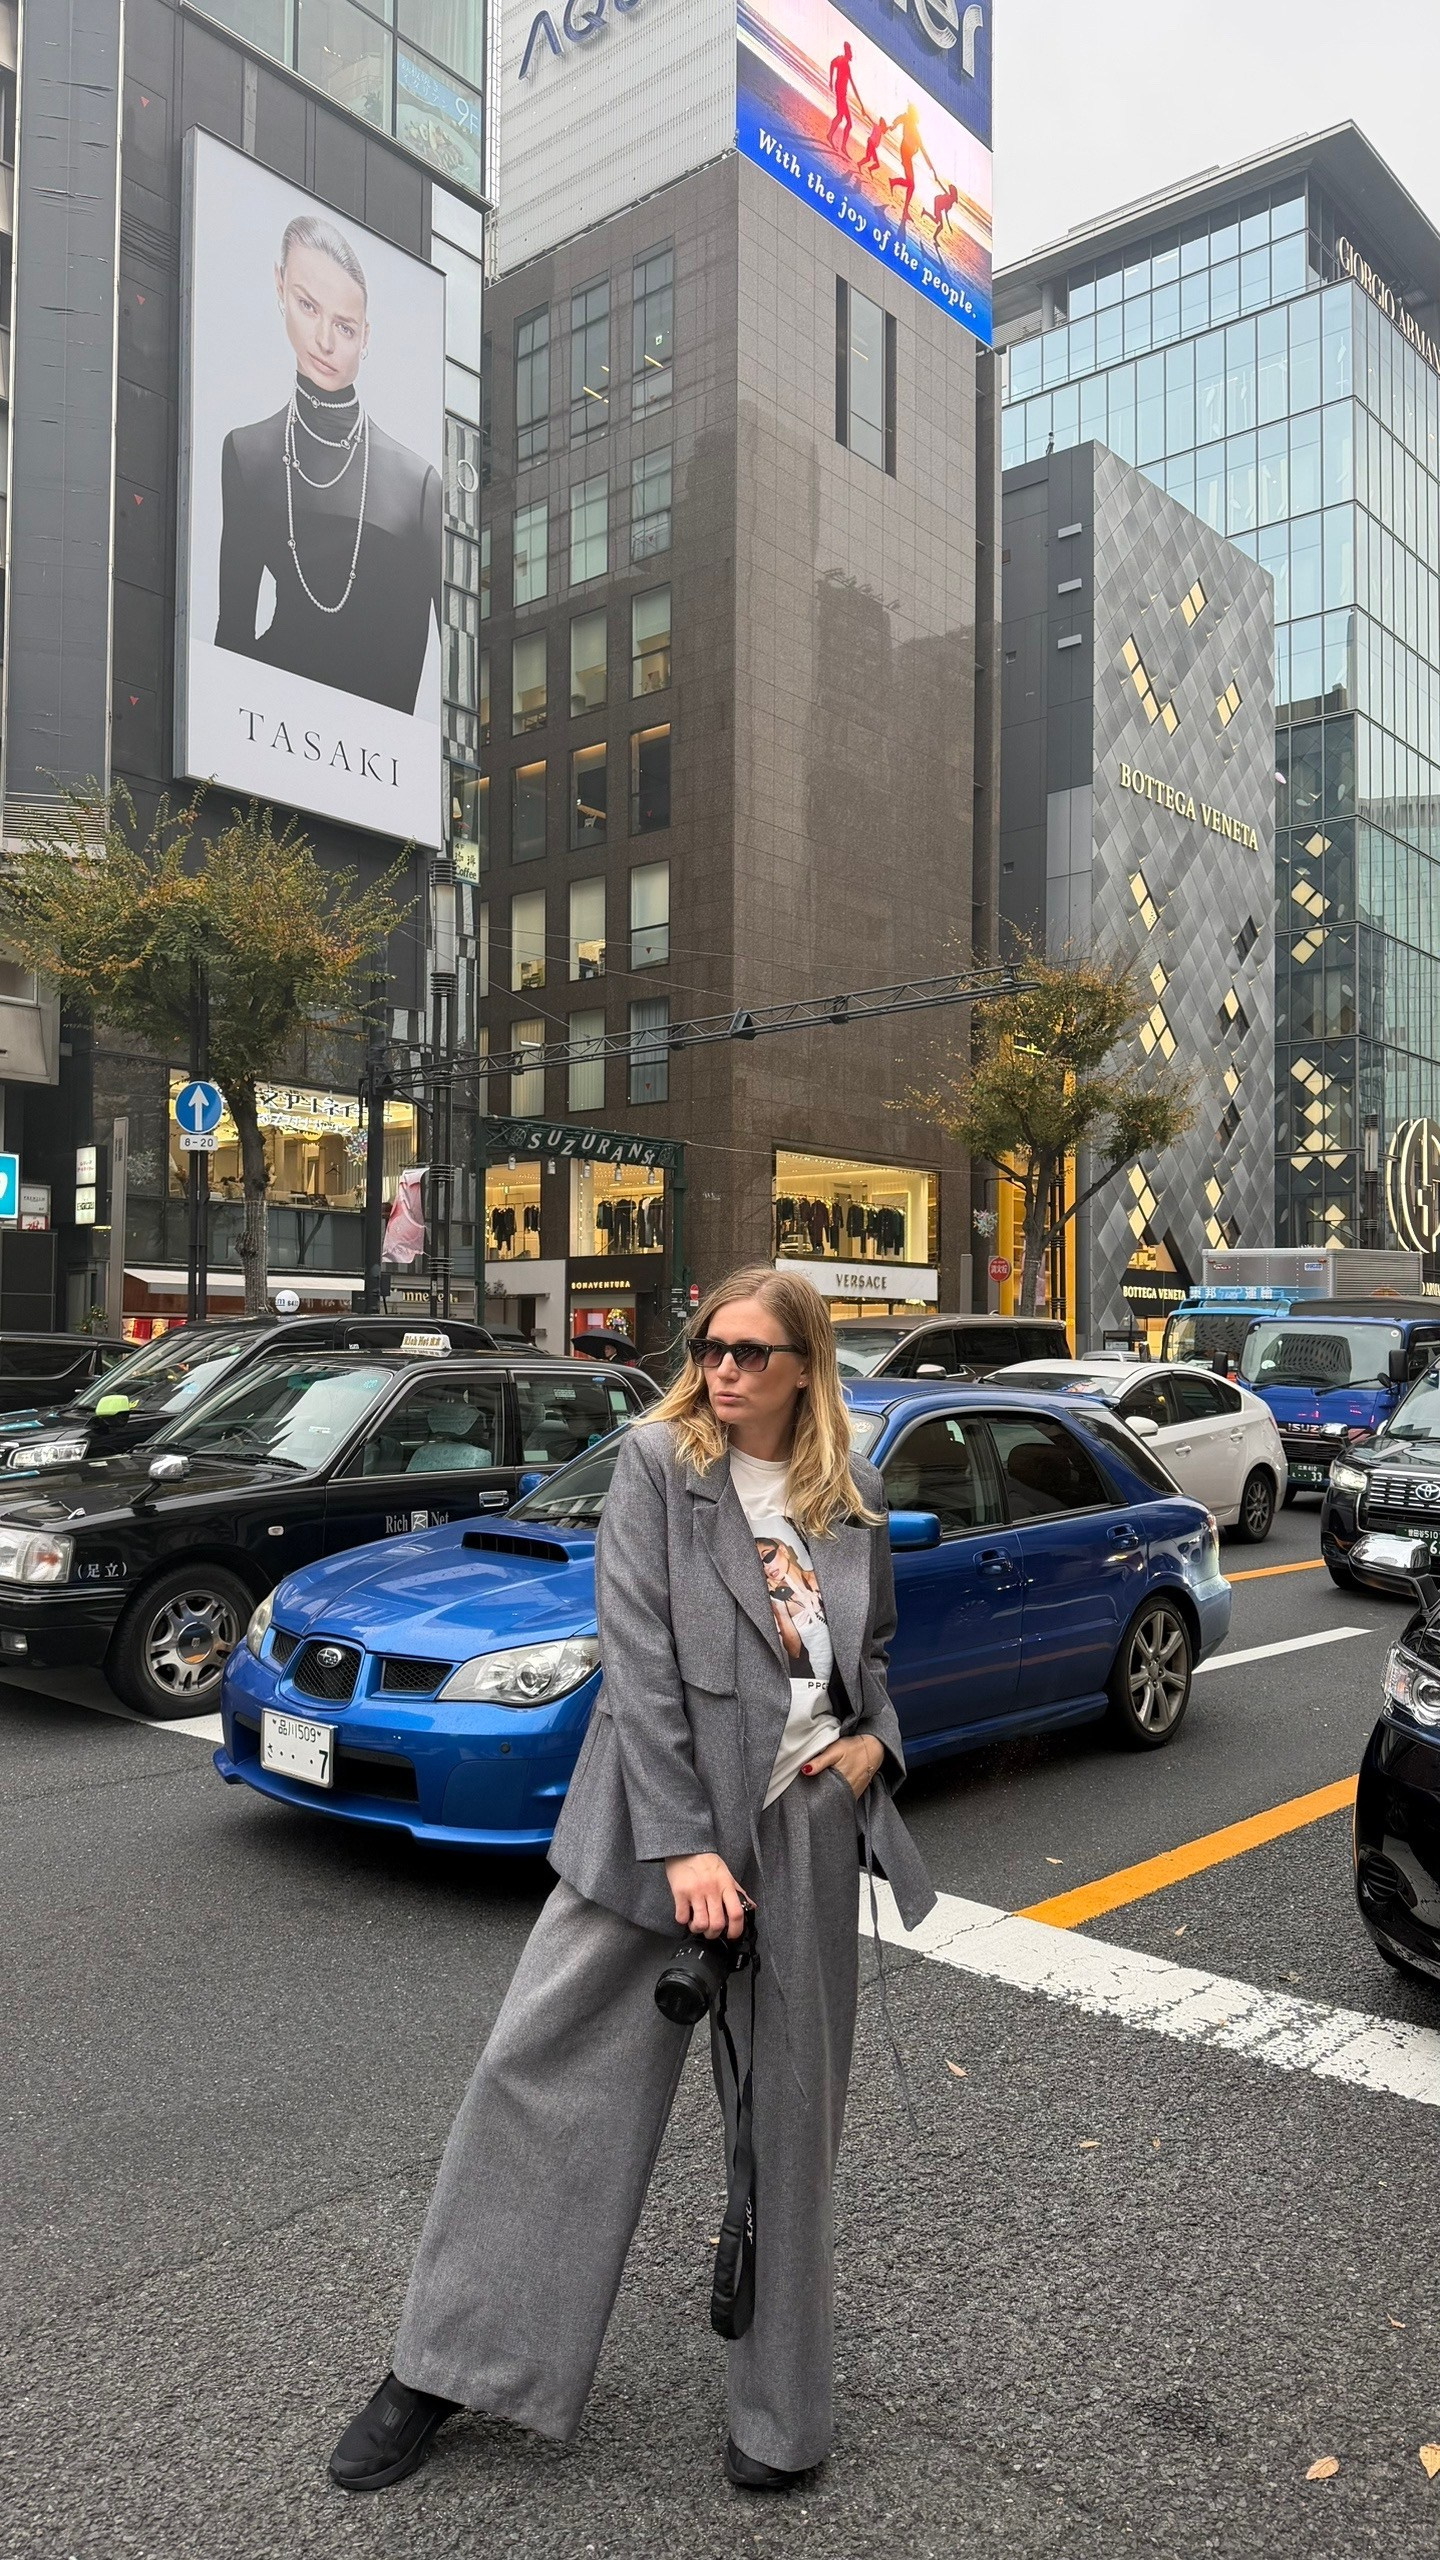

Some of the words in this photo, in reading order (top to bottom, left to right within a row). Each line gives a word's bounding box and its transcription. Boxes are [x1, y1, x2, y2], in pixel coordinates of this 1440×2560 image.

[893, 0, 983, 78] er
[455, 97, 479, 134] 9F
[758, 128, 801, 178] With
[807, 171, 835, 204] the
[838, 196, 867, 232] joy
[873, 227, 893, 251] of
[894, 241, 918, 271] the
[922, 266, 978, 319] people.
[1339, 236, 1396, 320] GIORGIO
[239, 707, 399, 787] TASAKI
[1120, 762, 1197, 821] BOTTEGA
[1200, 802, 1259, 852] VENETA
[527, 1129, 643, 1162] SUZURAN
[571, 1280, 631, 1290] BONAVENTURA
[836, 1273, 888, 1290] VERSACE
[1122, 1285, 1157, 1299] BOTTEGA
[1158, 1288, 1186, 1301] VENETA
[385, 1514, 408, 1533] Rich
[430, 1511, 449, 1525] Net
